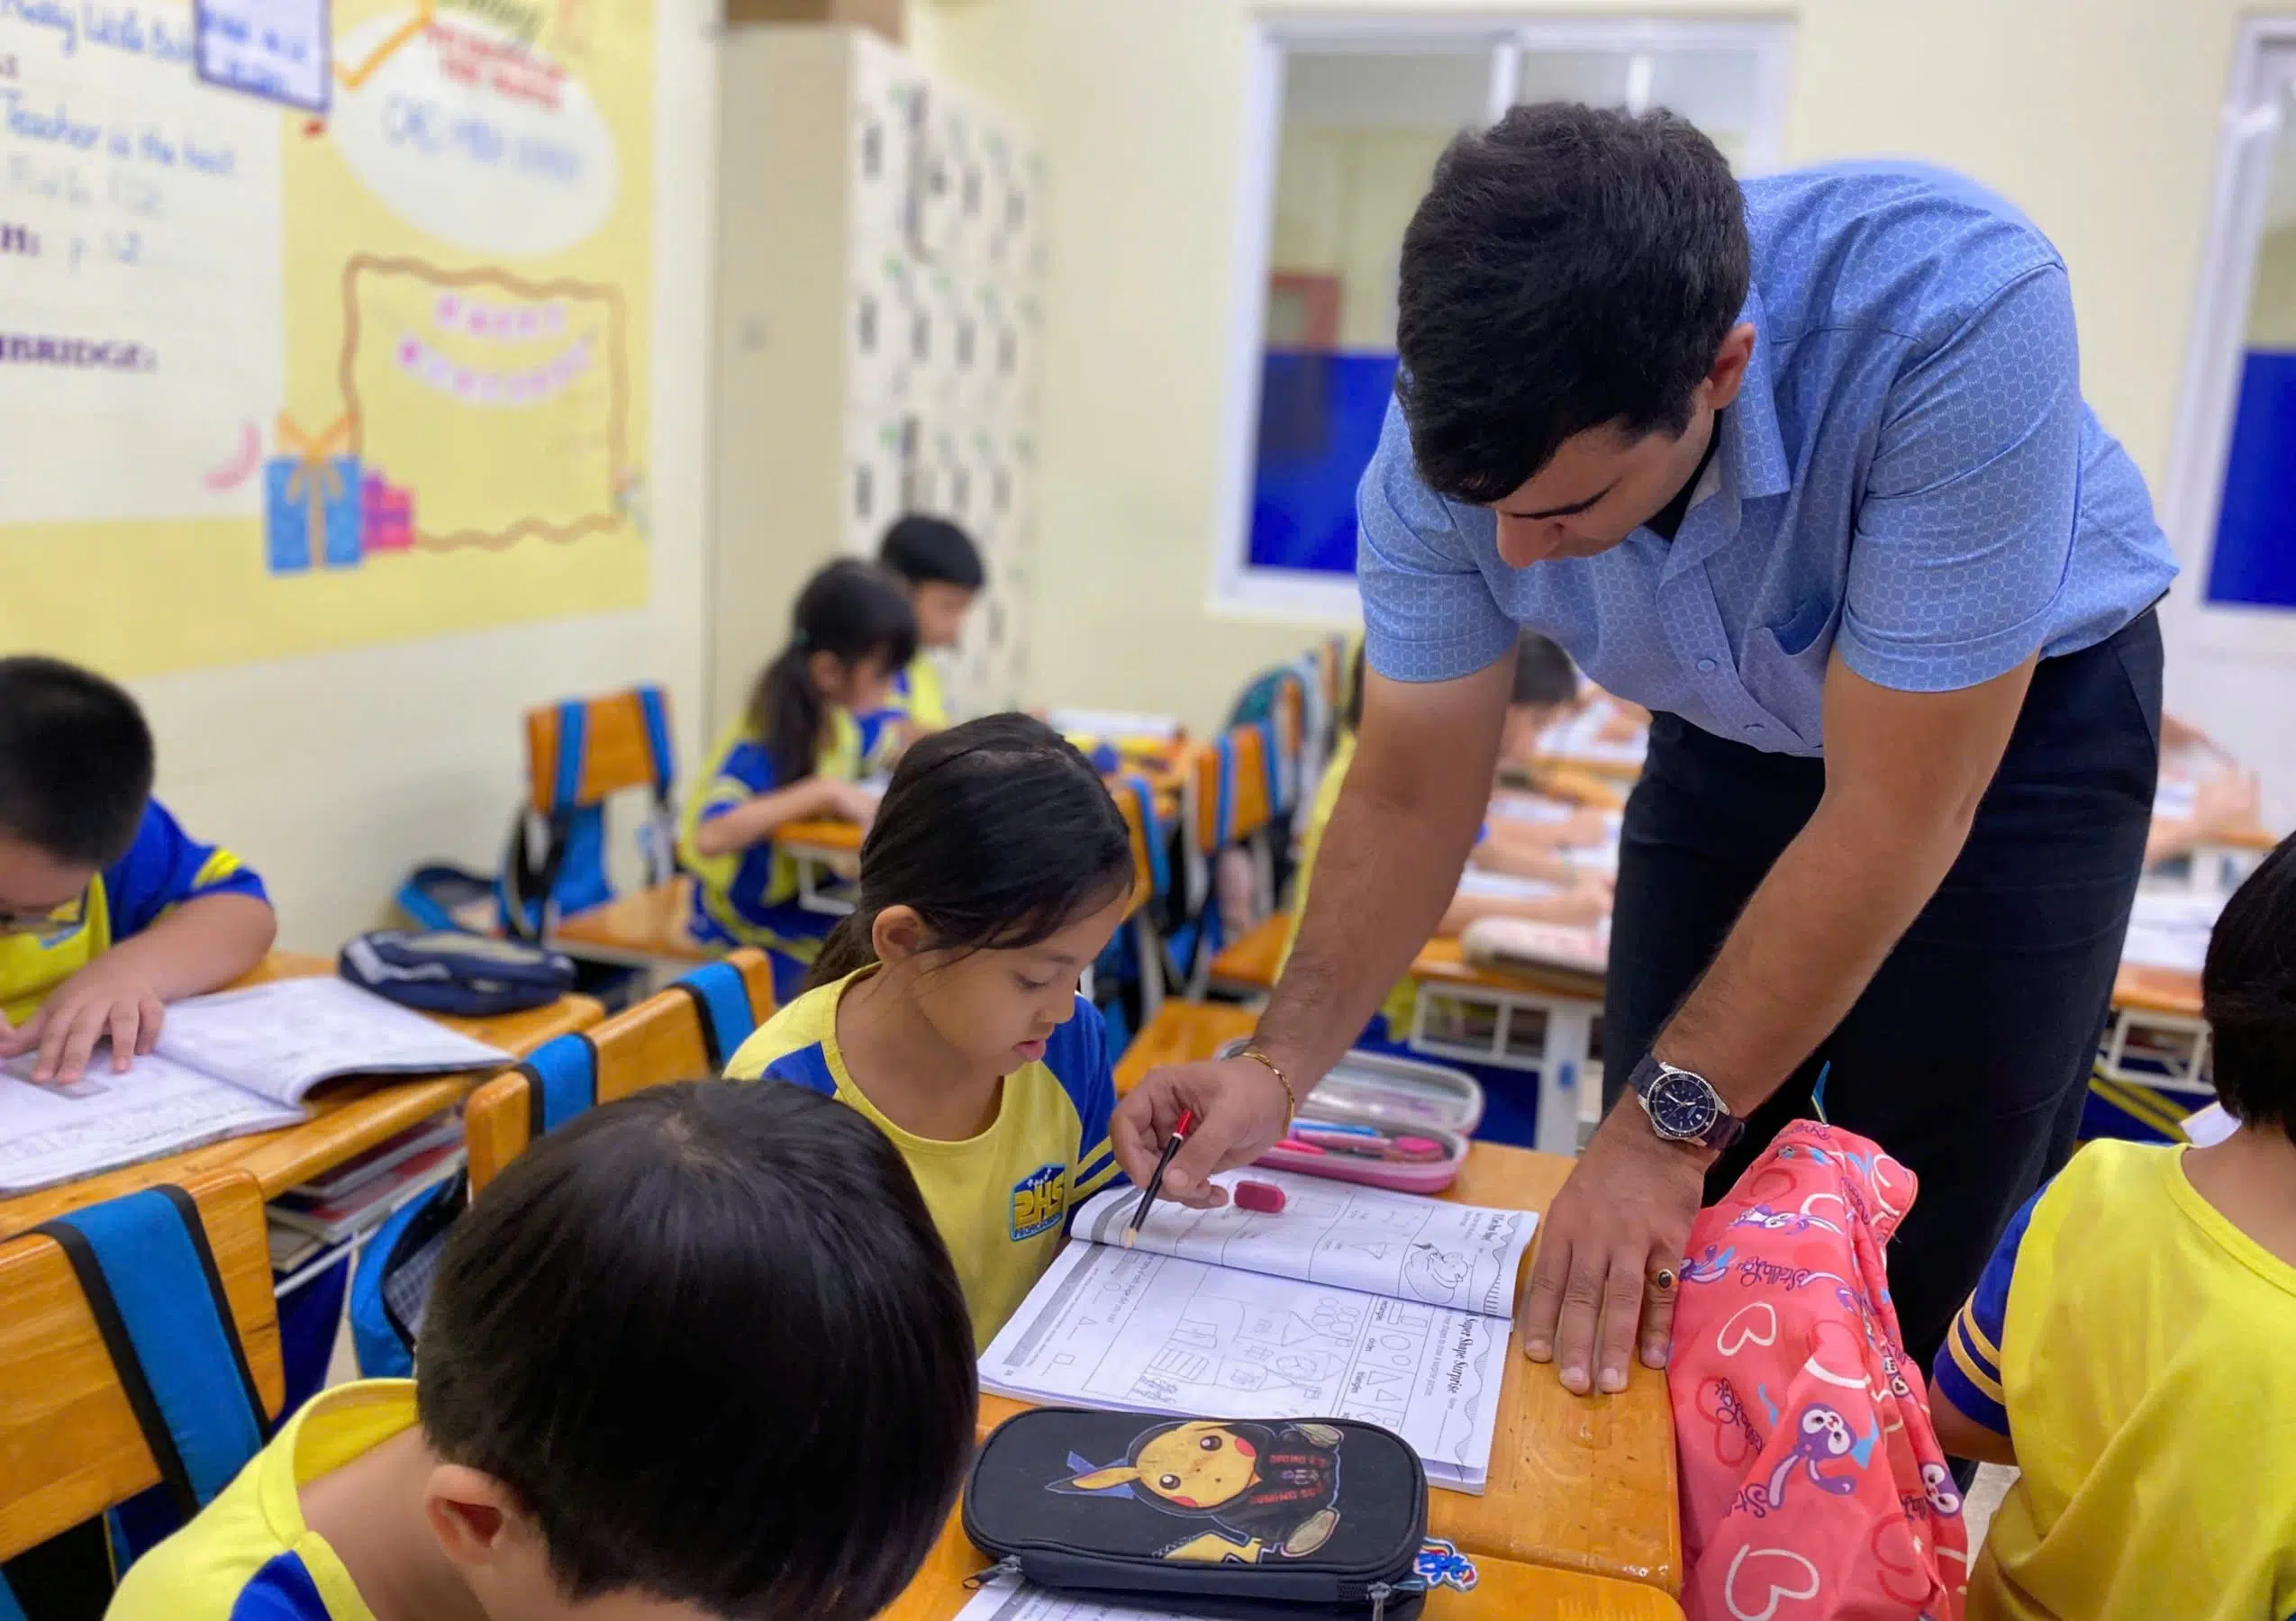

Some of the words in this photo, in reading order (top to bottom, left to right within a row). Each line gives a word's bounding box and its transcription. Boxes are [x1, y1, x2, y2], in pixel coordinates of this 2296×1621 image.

[1457, 1317, 1479, 1337] Super
[1452, 1338, 1475, 1360] Shape
[1446, 1361, 1469, 1394] Surprise
